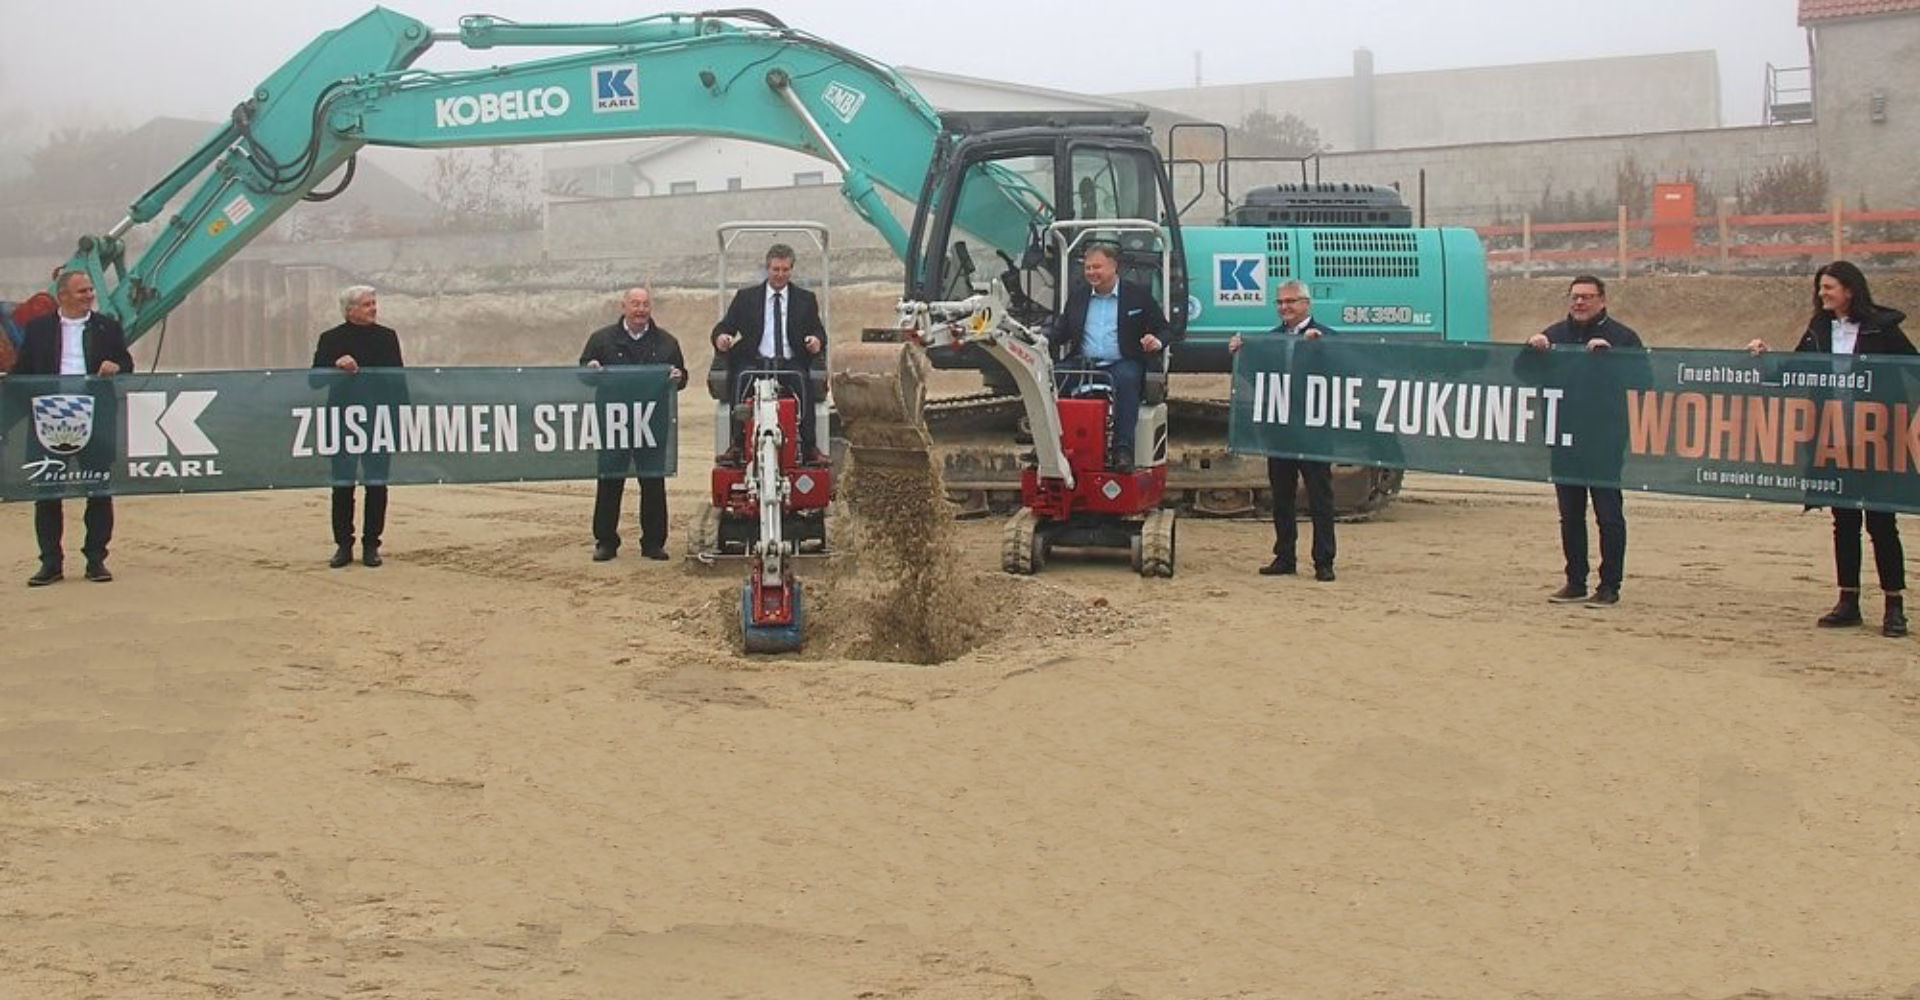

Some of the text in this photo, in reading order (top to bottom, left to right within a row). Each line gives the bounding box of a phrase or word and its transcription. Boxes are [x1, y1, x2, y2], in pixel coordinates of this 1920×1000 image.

[435, 86, 570, 128] KOBELCO
[598, 99, 637, 108] KARL
[1219, 293, 1263, 301] KARL
[1252, 372, 1574, 447] IN DIE ZUKUNFT.
[291, 401, 657, 458] ZUSAMMEN STARK
[1626, 389, 1920, 475] WOHNPARK
[128, 460, 223, 477] KARL
[1719, 471, 1755, 485] projekt
[1756, 473, 1774, 487] der
